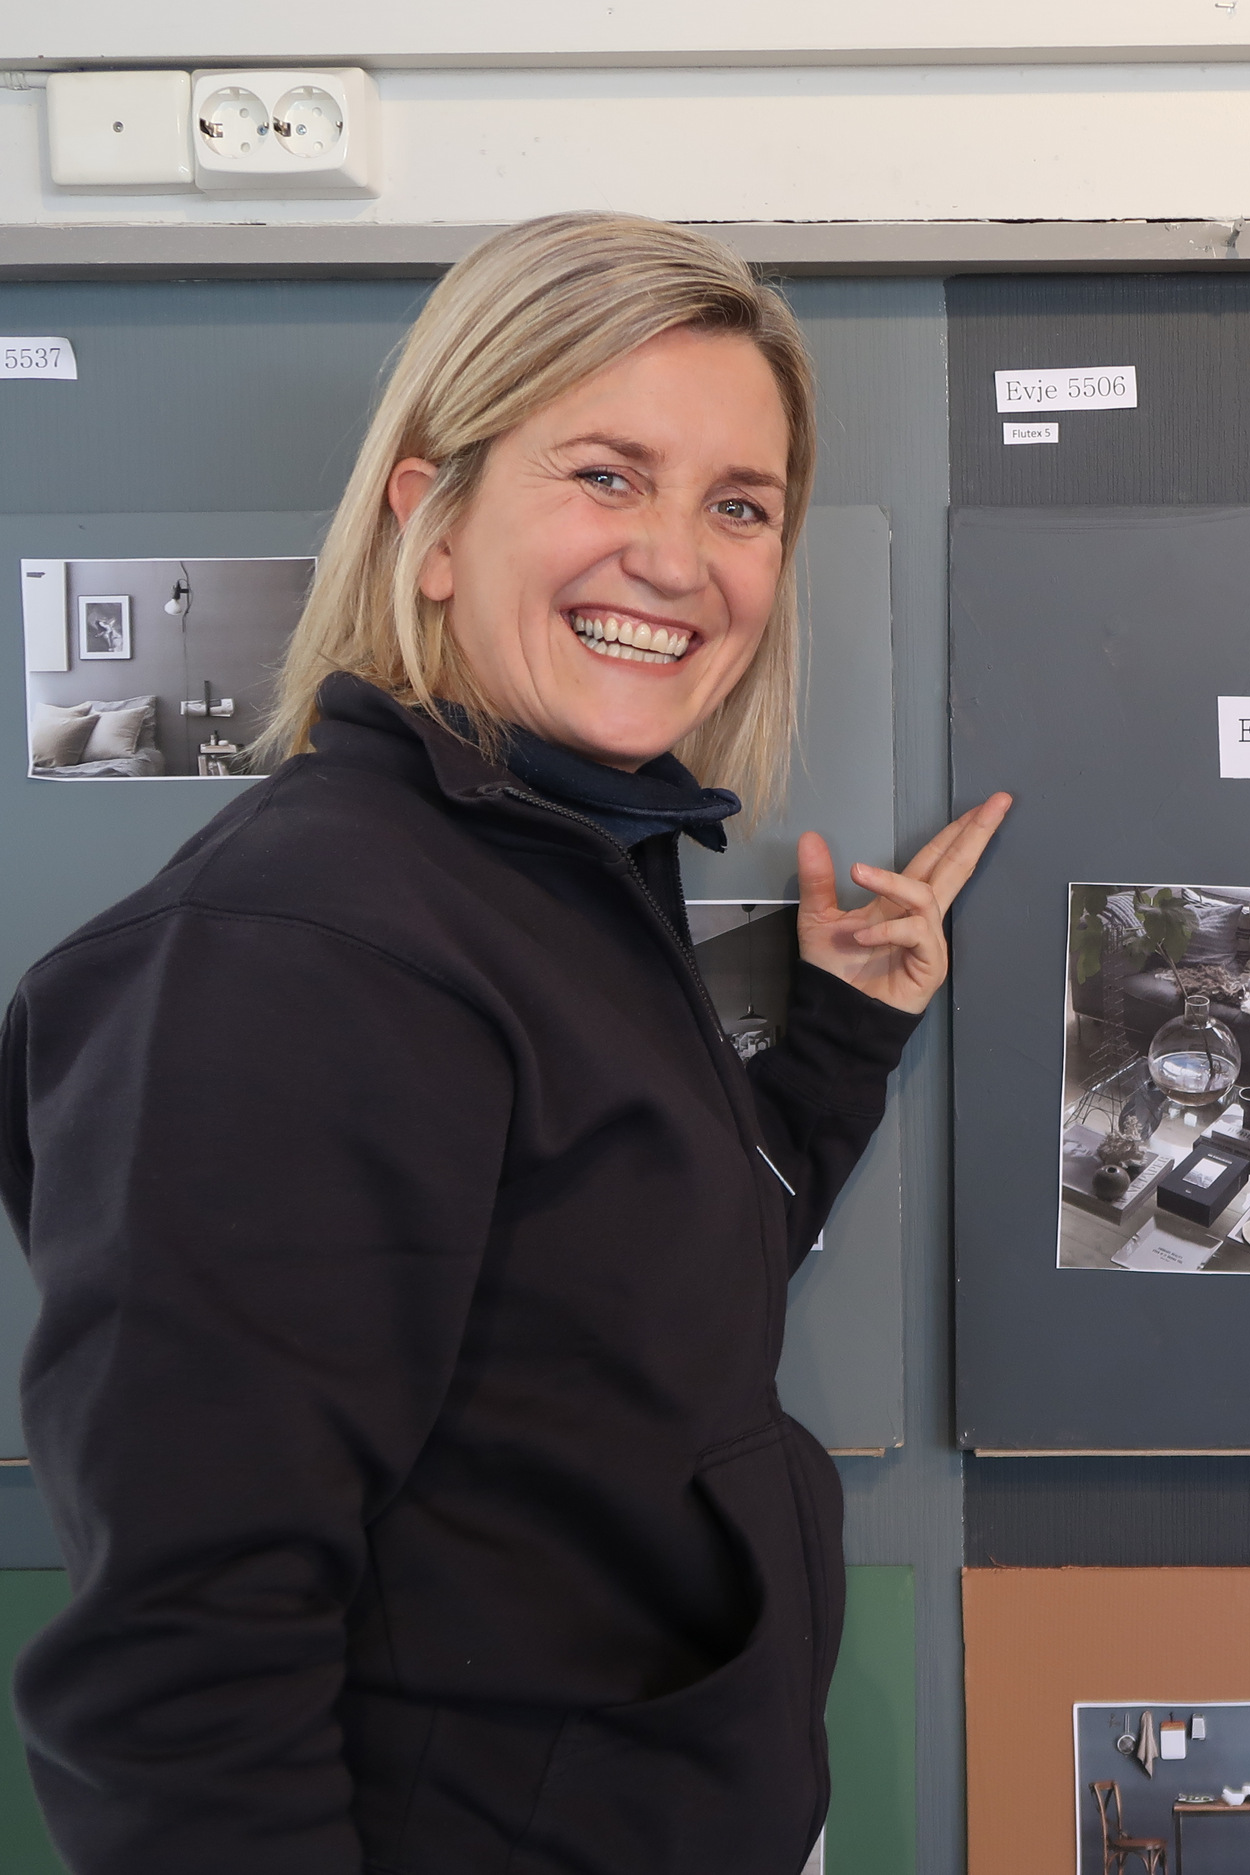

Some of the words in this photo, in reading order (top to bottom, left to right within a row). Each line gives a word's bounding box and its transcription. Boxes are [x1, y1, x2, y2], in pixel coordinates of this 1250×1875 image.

[4, 347, 61, 369] 5537
[1005, 379, 1058, 403] Evje
[1067, 375, 1127, 398] 5506
[1011, 429, 1043, 438] Flutex
[1044, 428, 1051, 438] 5
